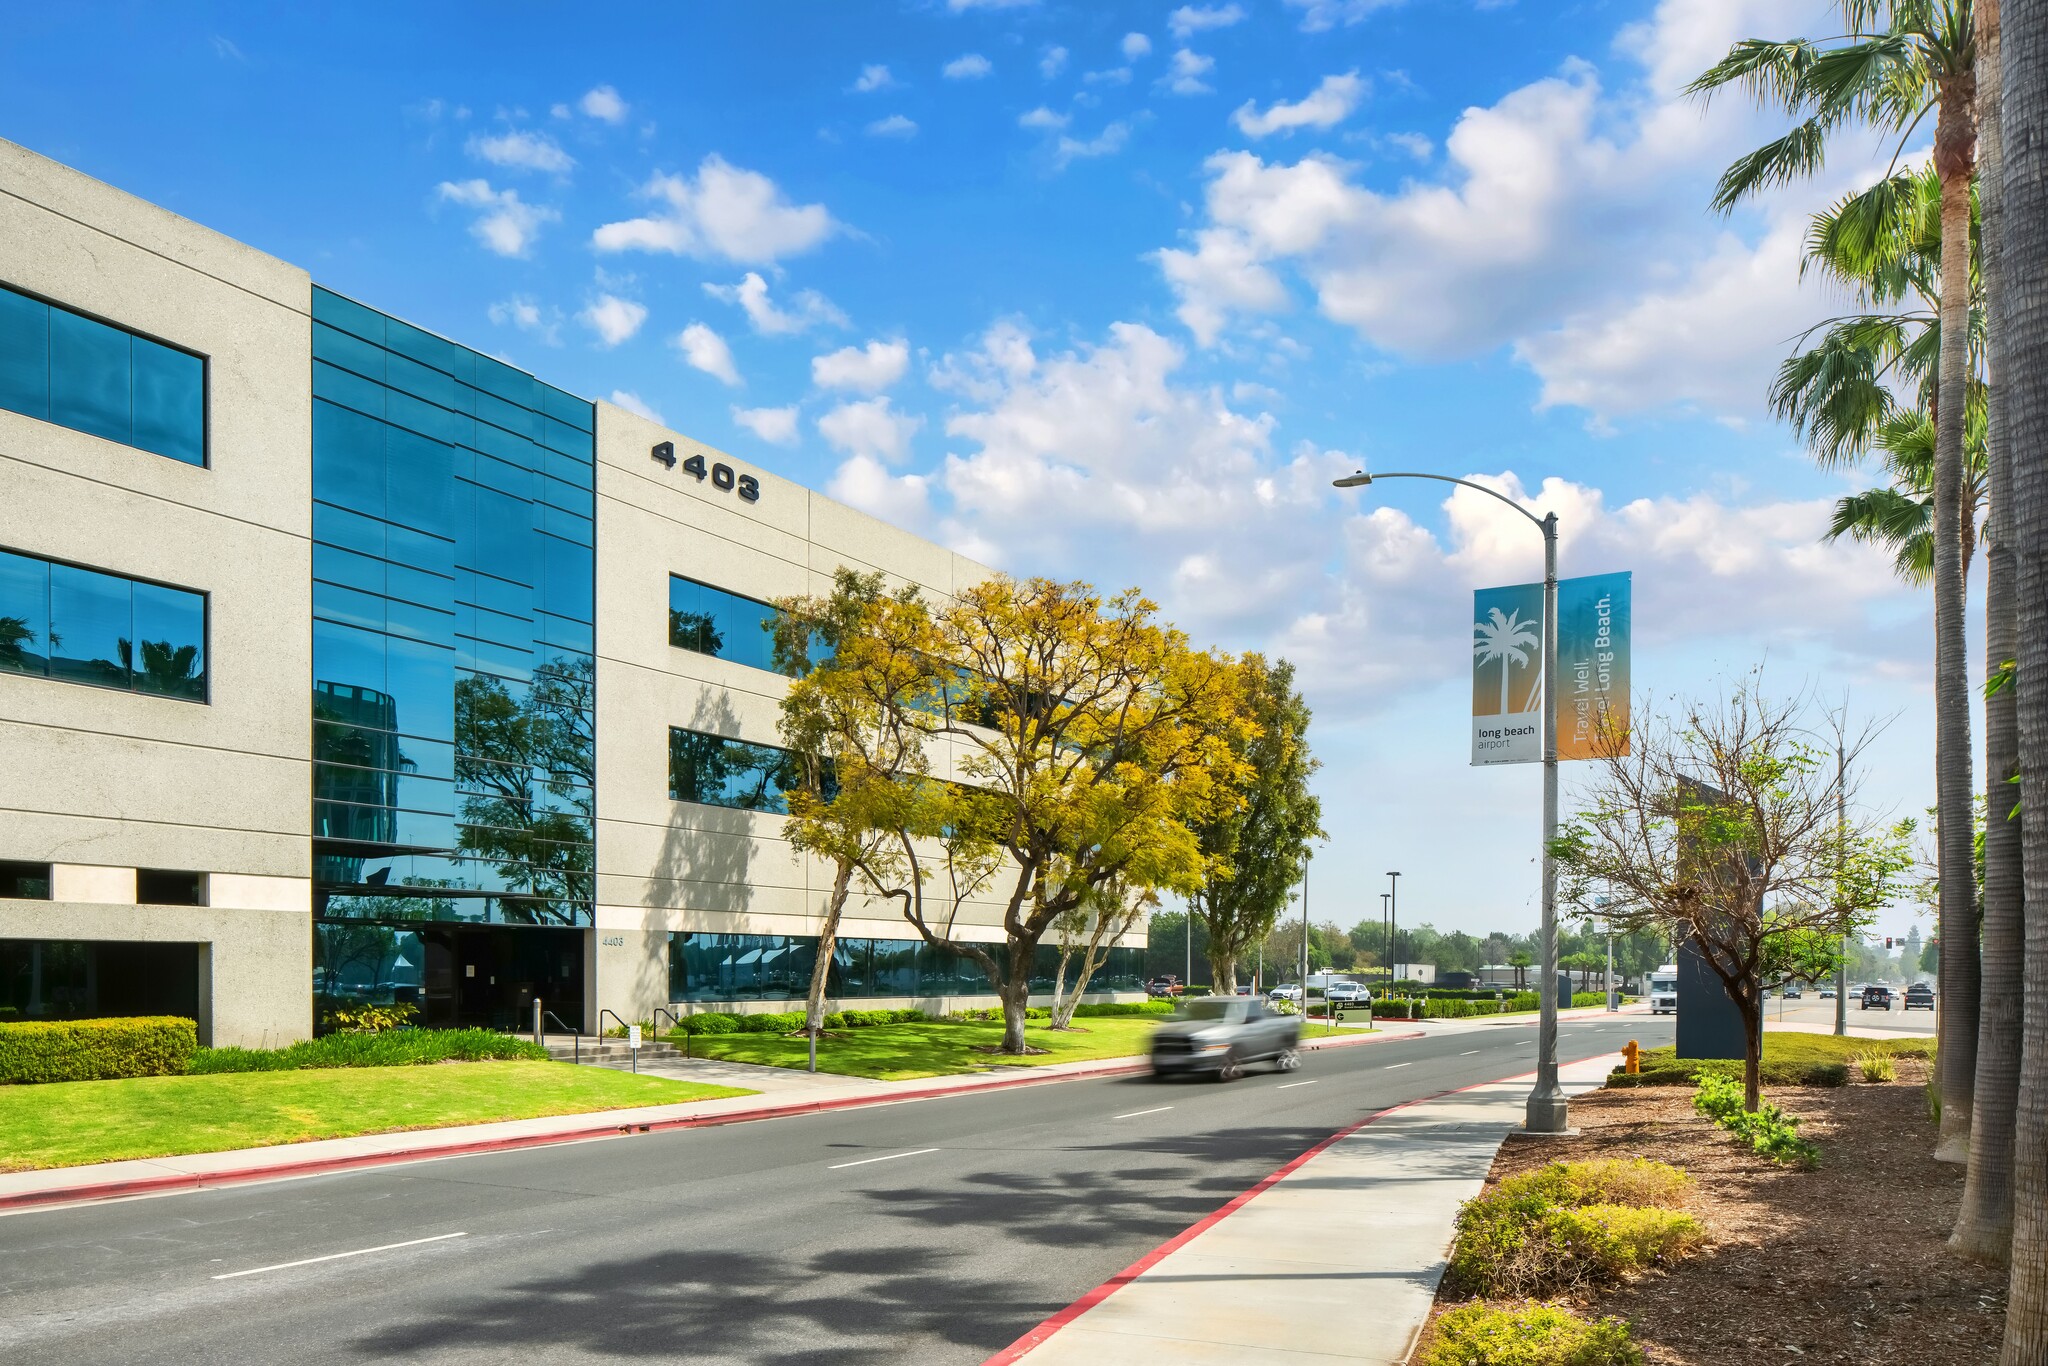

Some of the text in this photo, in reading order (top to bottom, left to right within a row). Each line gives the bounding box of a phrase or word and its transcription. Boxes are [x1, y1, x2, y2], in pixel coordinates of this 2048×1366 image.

[652, 441, 760, 502] 4403
[1594, 593, 1611, 648] Beach.
[1595, 652, 1614, 693] Long
[1574, 657, 1589, 744] Travel Well.
[1478, 725, 1535, 739] long beach
[1478, 739, 1510, 750] airport
[602, 936, 623, 946] 4403
